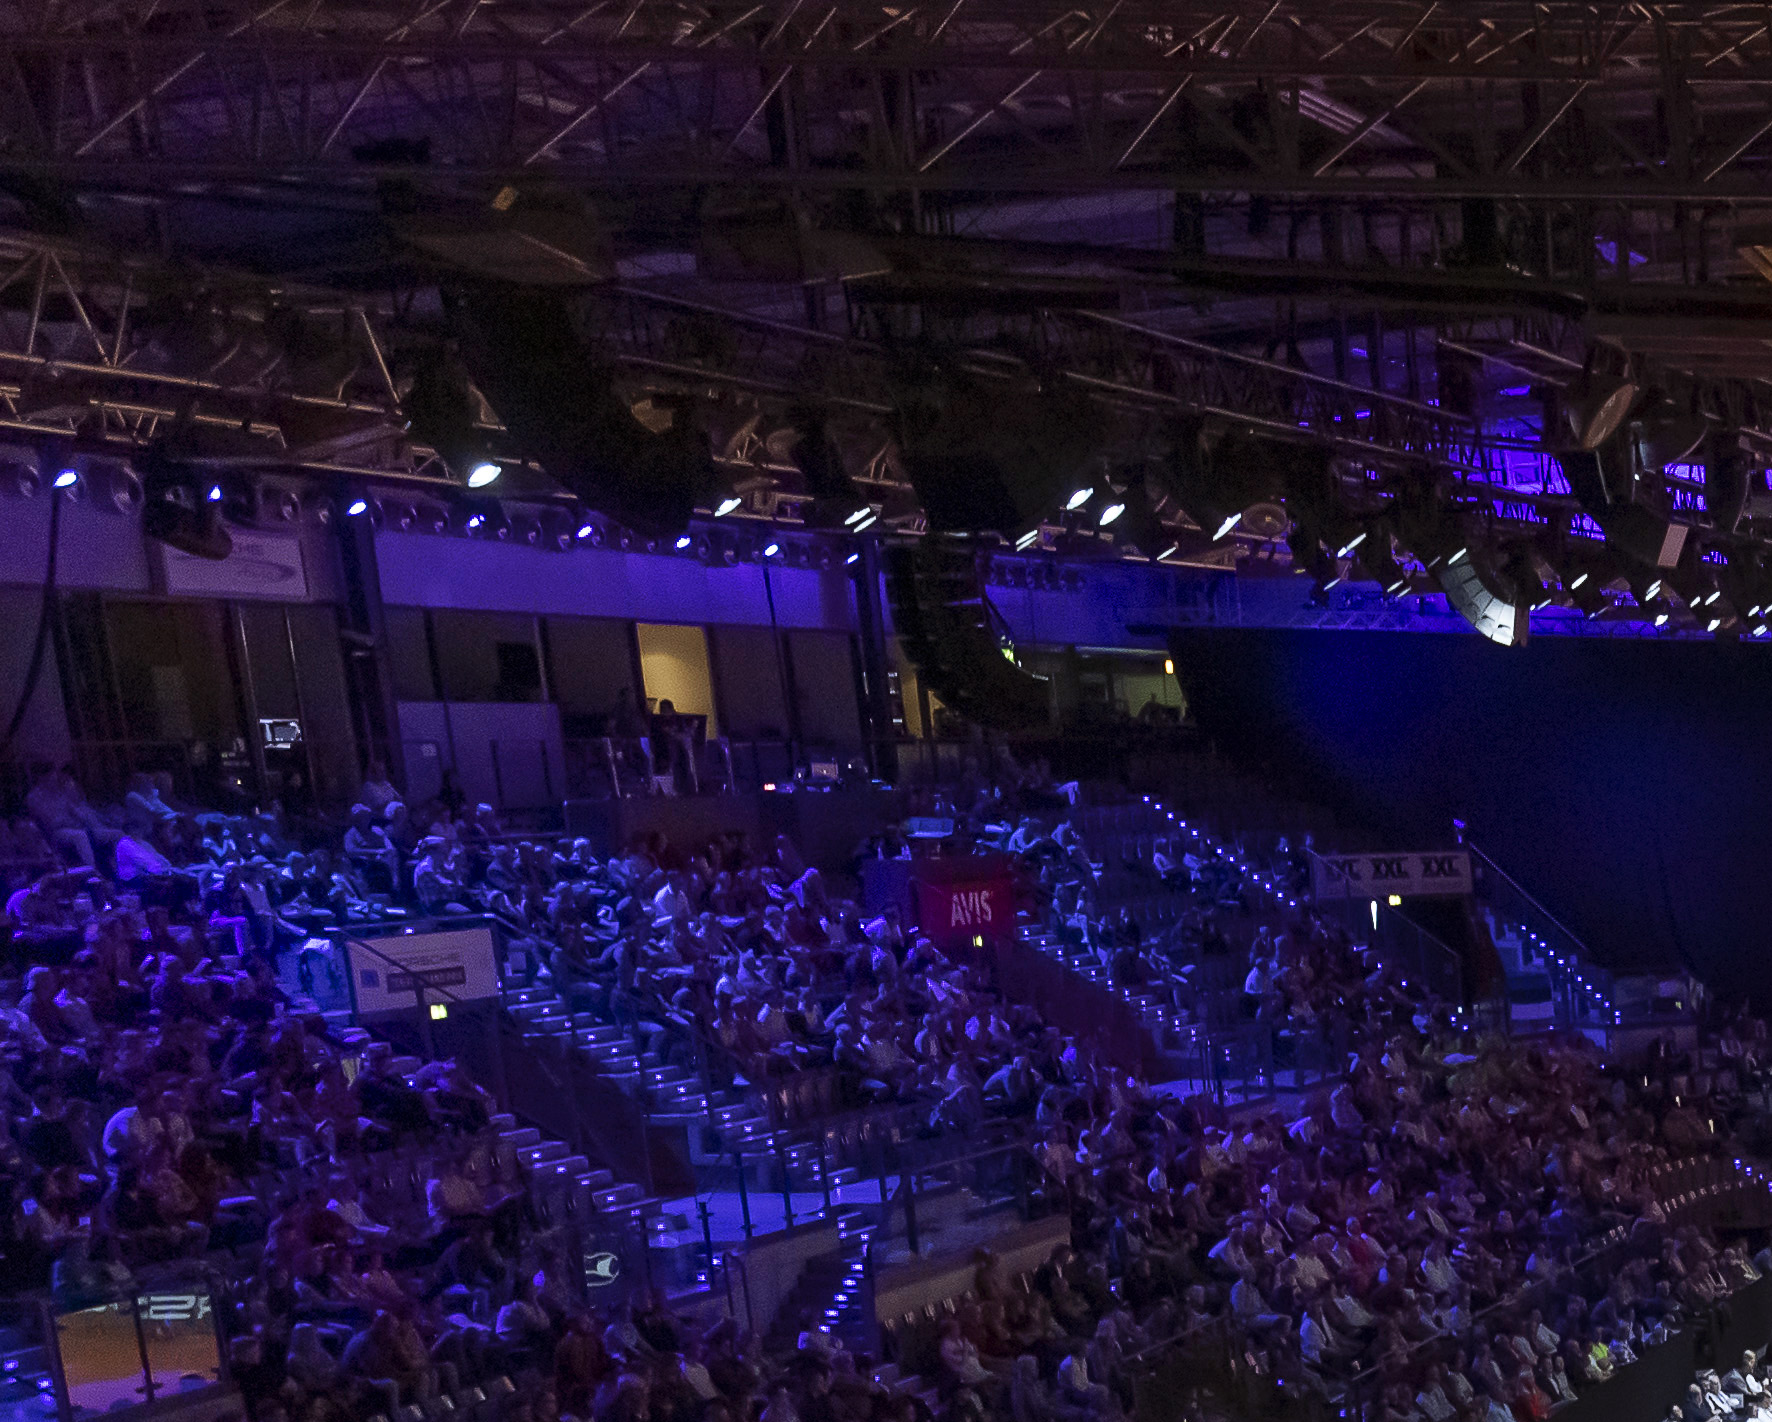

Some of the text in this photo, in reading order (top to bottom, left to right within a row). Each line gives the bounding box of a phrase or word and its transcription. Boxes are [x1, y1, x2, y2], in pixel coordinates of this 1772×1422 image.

[1370, 858, 1410, 880] XXL
[1420, 856, 1462, 878] XXL
[951, 890, 992, 927] AVIS
